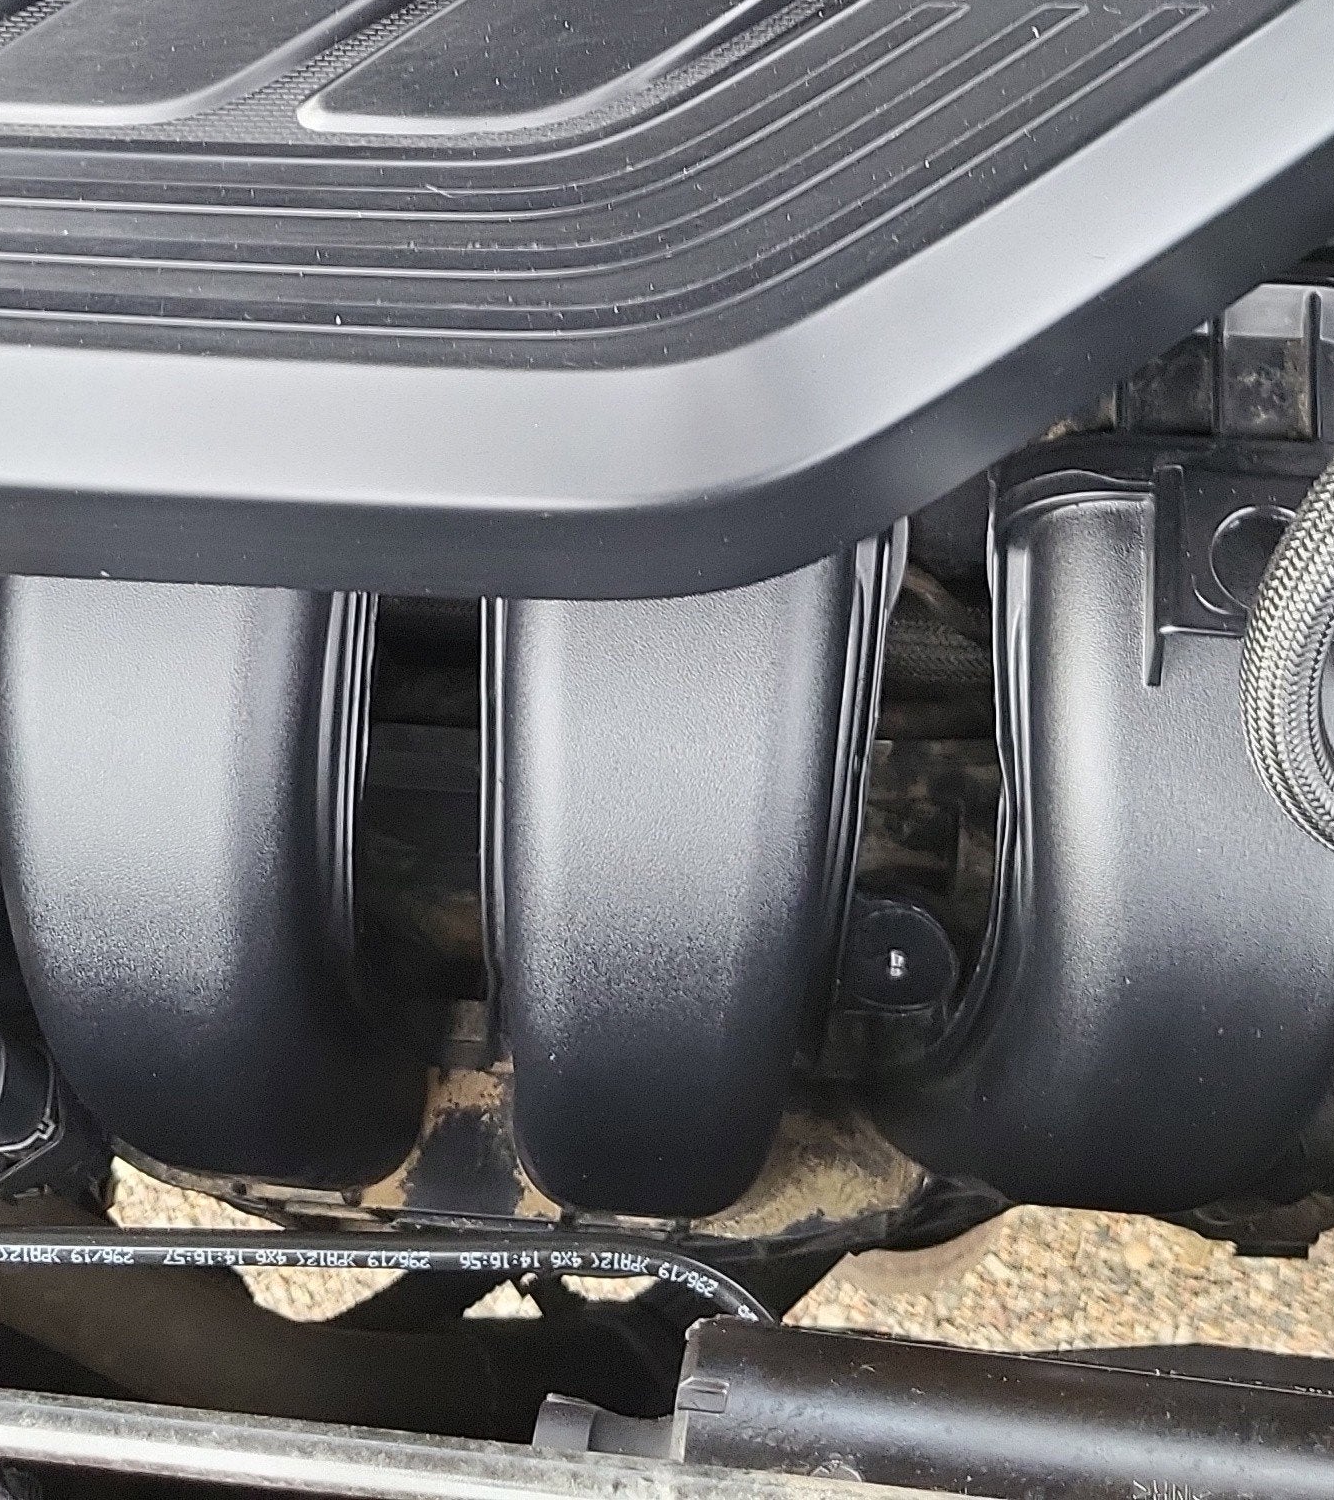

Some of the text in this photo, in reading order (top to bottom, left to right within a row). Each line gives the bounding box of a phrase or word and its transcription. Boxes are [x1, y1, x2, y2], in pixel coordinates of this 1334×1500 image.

[163, 1249, 245, 1266] 14:16:57
[368, 1250, 431, 1268] 296/19
[459, 1250, 540, 1270] 14:16:56
[658, 1262, 719, 1299] 296/19
